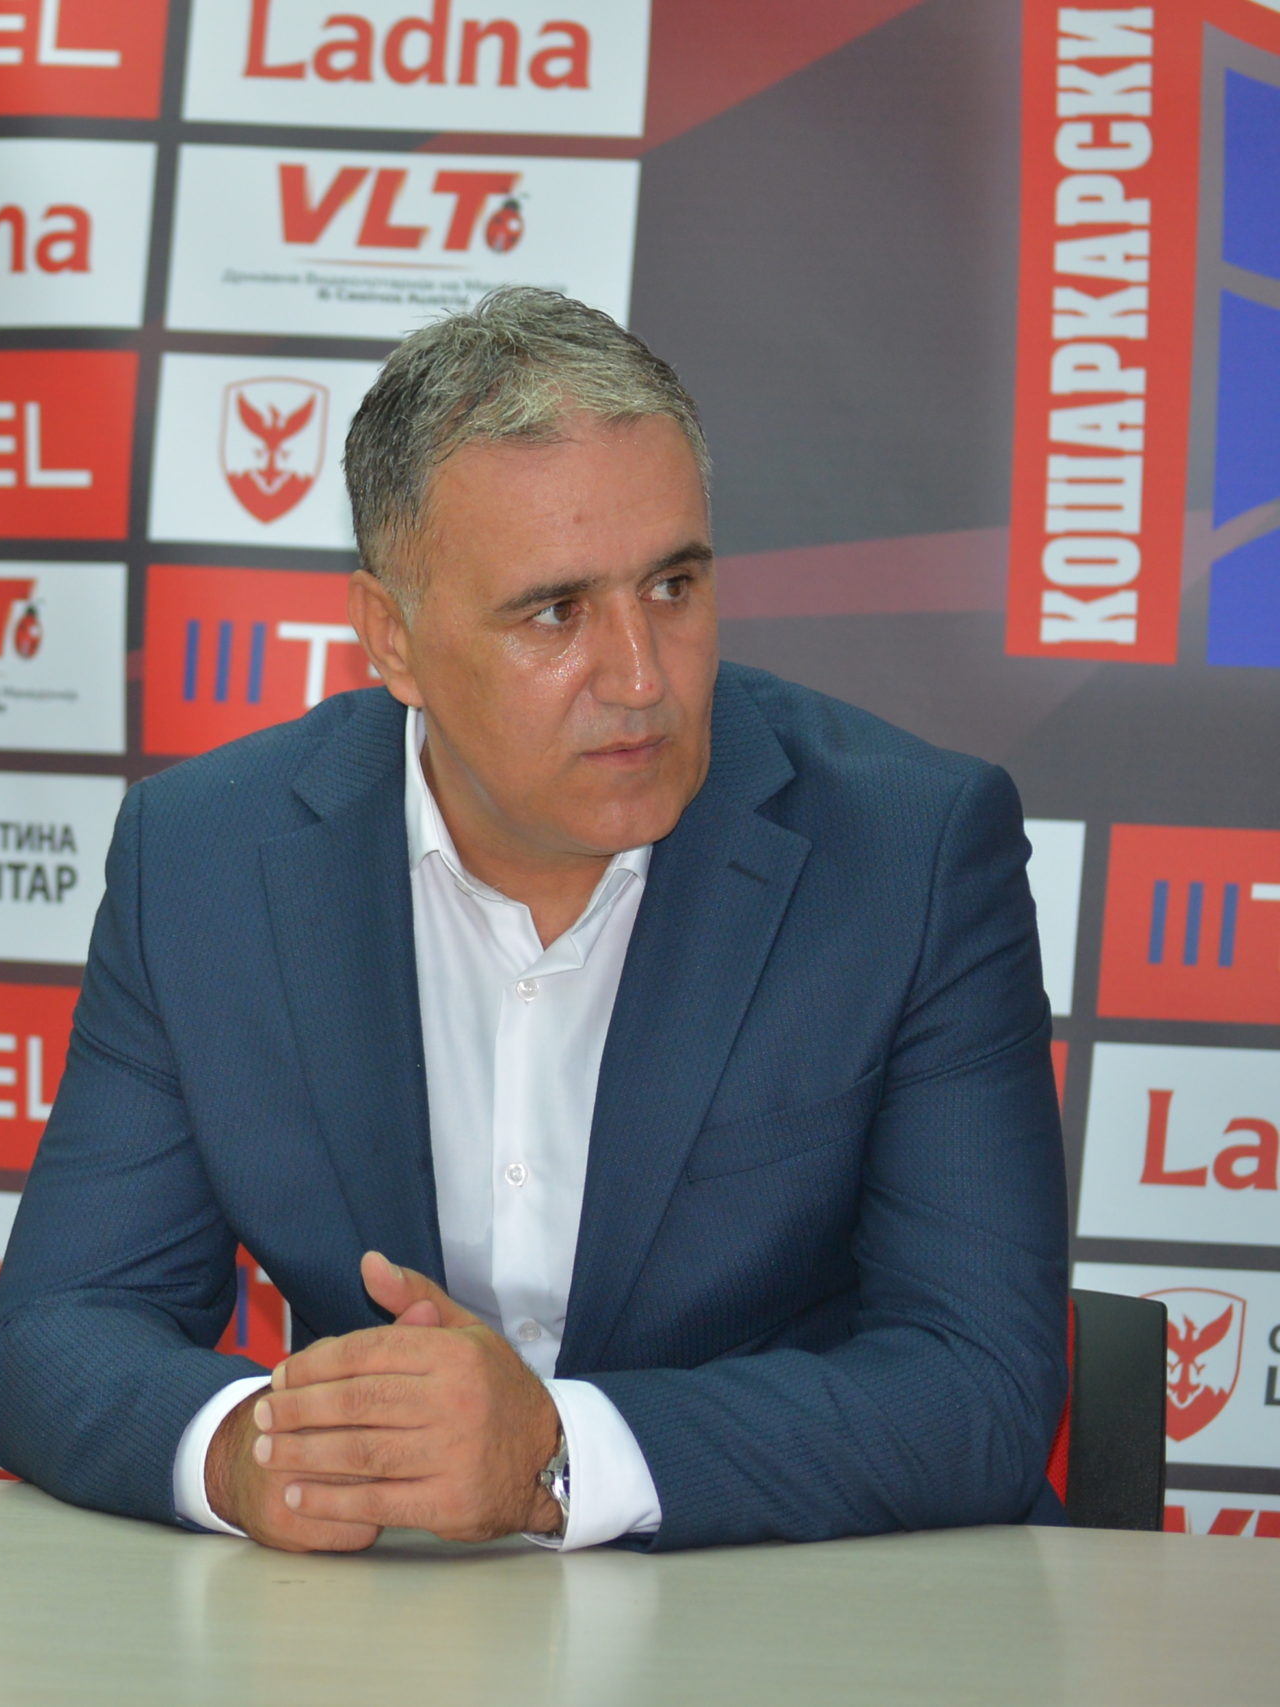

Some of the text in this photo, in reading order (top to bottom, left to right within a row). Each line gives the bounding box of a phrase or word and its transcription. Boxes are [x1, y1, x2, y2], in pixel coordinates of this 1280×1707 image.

[242, 0, 591, 91] Ladna
[277, 163, 523, 252] VLT
[1040, 7, 1154, 645] КОШАРКАРСКИ
